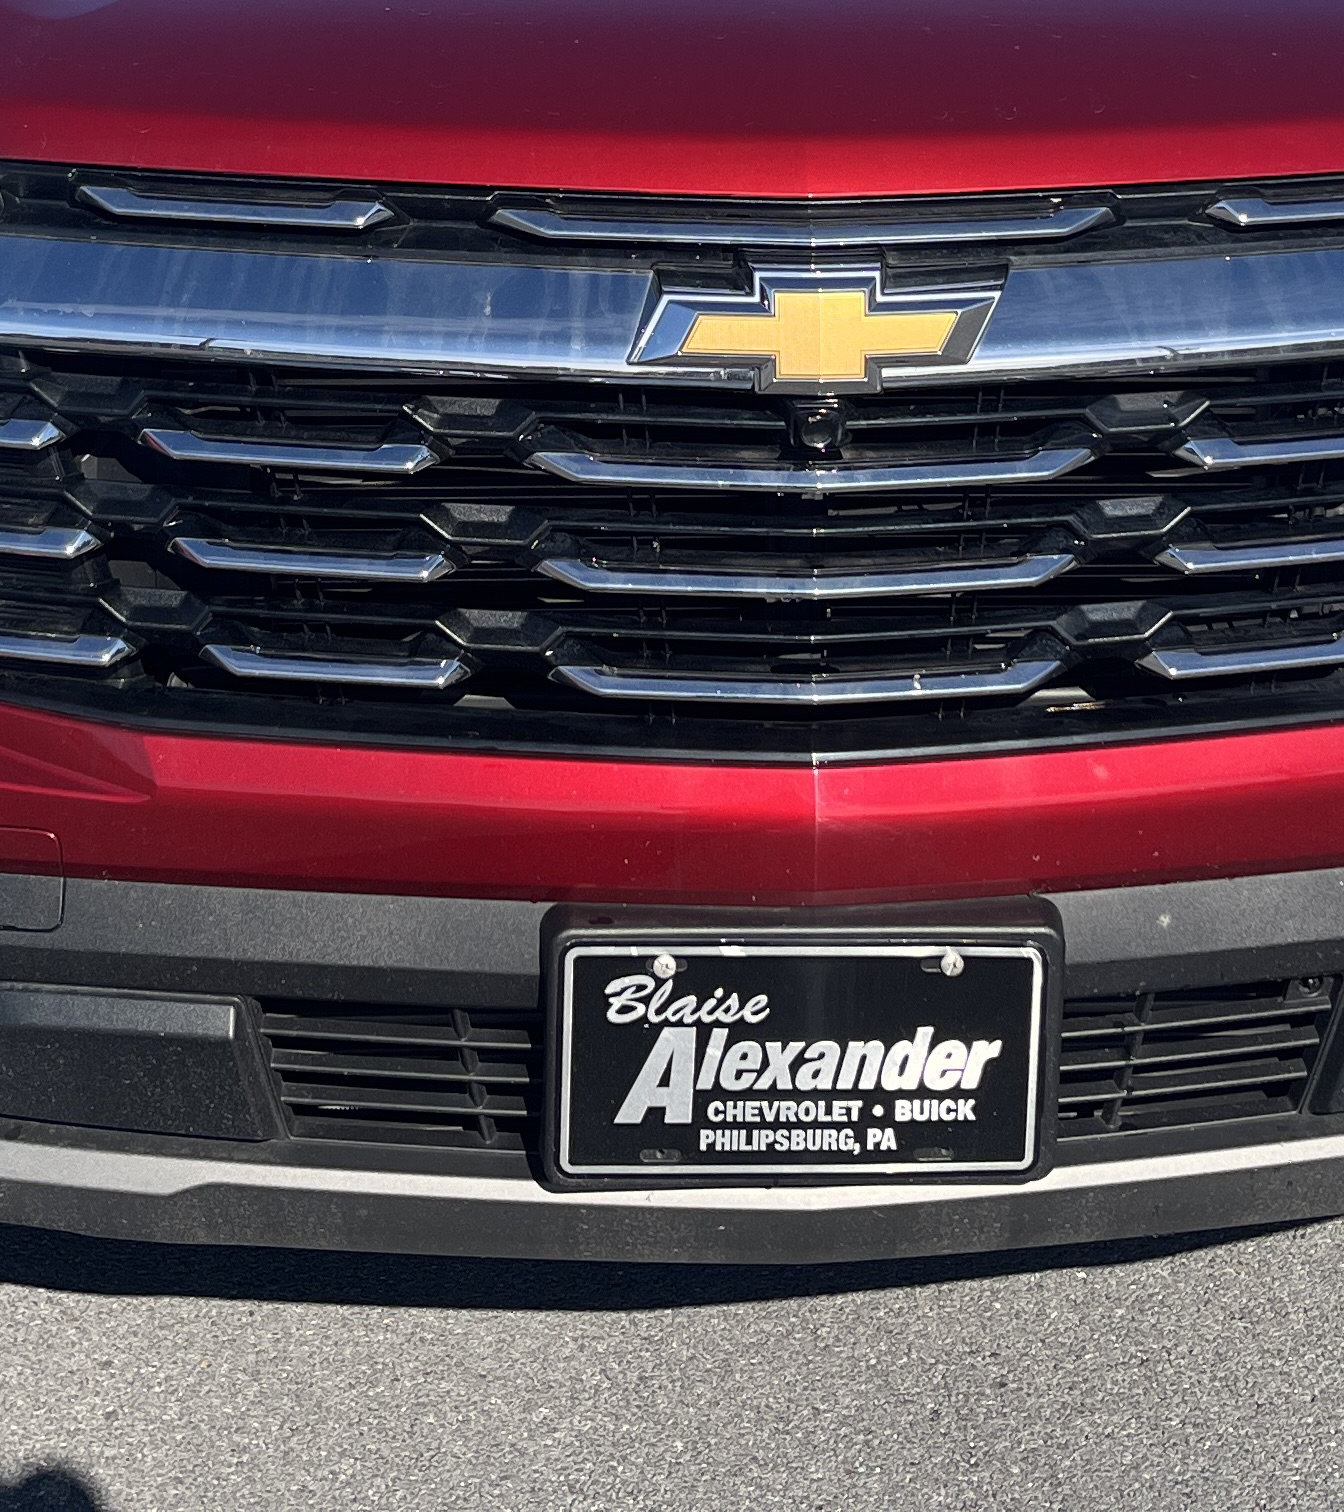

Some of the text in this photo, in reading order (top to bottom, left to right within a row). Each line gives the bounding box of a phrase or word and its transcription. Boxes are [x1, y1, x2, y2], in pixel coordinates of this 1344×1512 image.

[604, 974, 770, 1024] Blaise
[613, 1026, 1003, 1124] Alexander
[706, 1098, 976, 1123] CHEVROLET BUICK
[699, 1127, 898, 1156] PHILIPSBURG, PA
